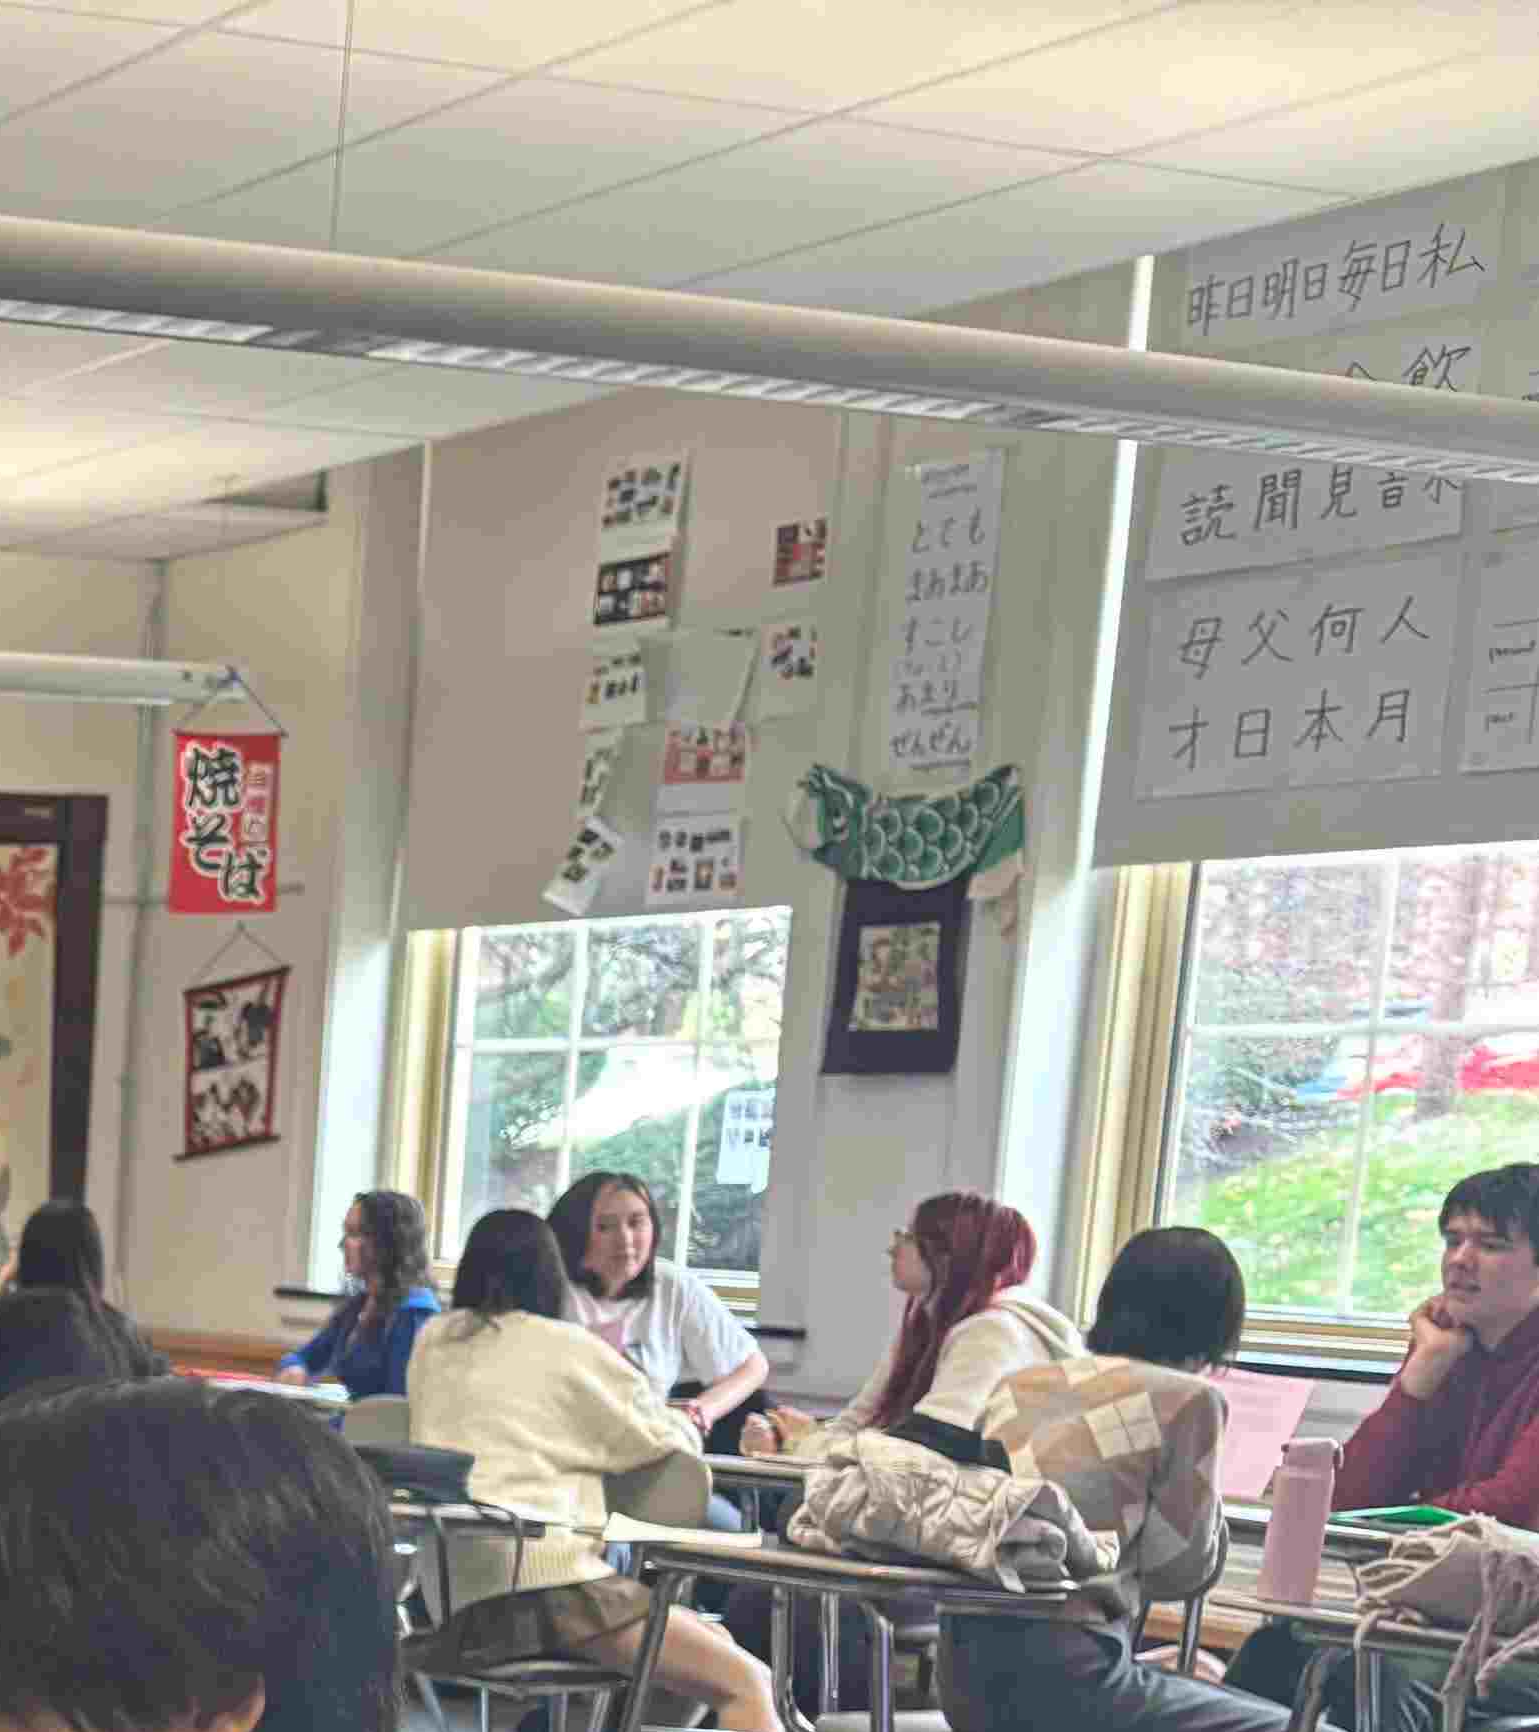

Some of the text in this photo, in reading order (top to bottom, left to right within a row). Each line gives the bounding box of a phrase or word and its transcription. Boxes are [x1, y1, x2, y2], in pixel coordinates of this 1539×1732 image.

[1176, 595, 1431, 681] 母父何人
[184, 743, 271, 901] 焼そば
